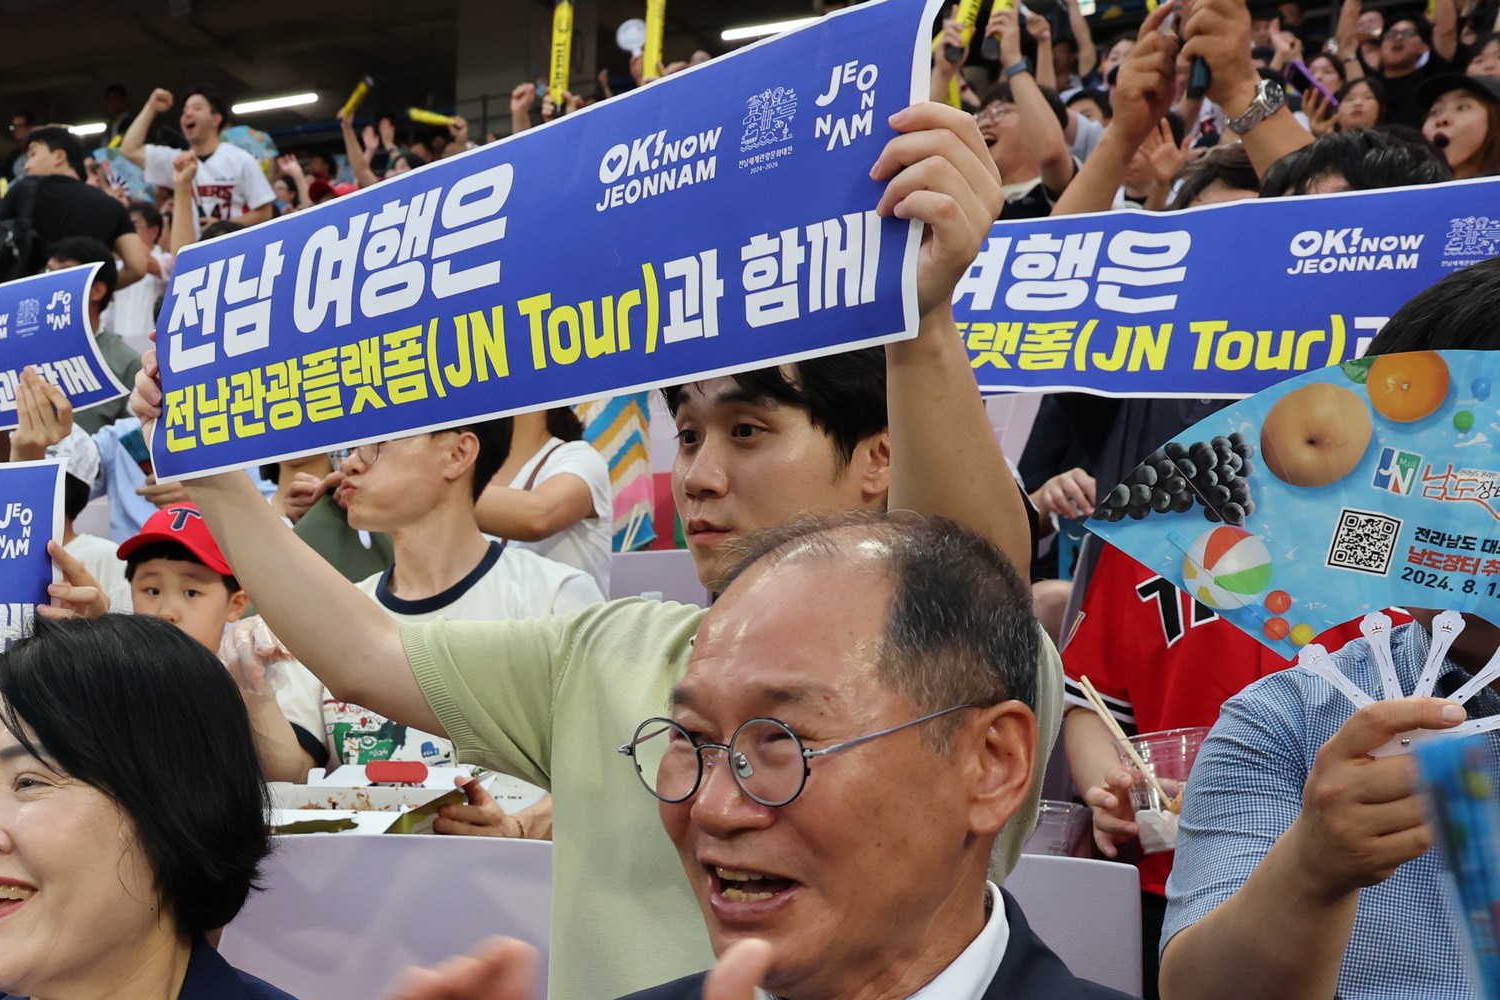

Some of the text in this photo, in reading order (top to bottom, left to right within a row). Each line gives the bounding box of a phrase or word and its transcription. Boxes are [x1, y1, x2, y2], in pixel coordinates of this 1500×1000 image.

[596, 155, 717, 211] JEONNAM
[167, 163, 515, 373] 전남 여행은
[1286, 253, 1419, 276] JEONNAM
[165, 209, 881, 453] 전남관광플랫폼(JN Tour)과 함께
[956, 319, 1174, 372] 랫폼(JN
[1408, 546, 1481, 575] 남도장터
[1414, 527, 1500, 555] 전라남도 대
[1401, 567, 1454, 592] 2024.
[1462, 579, 1478, 595] 8.
